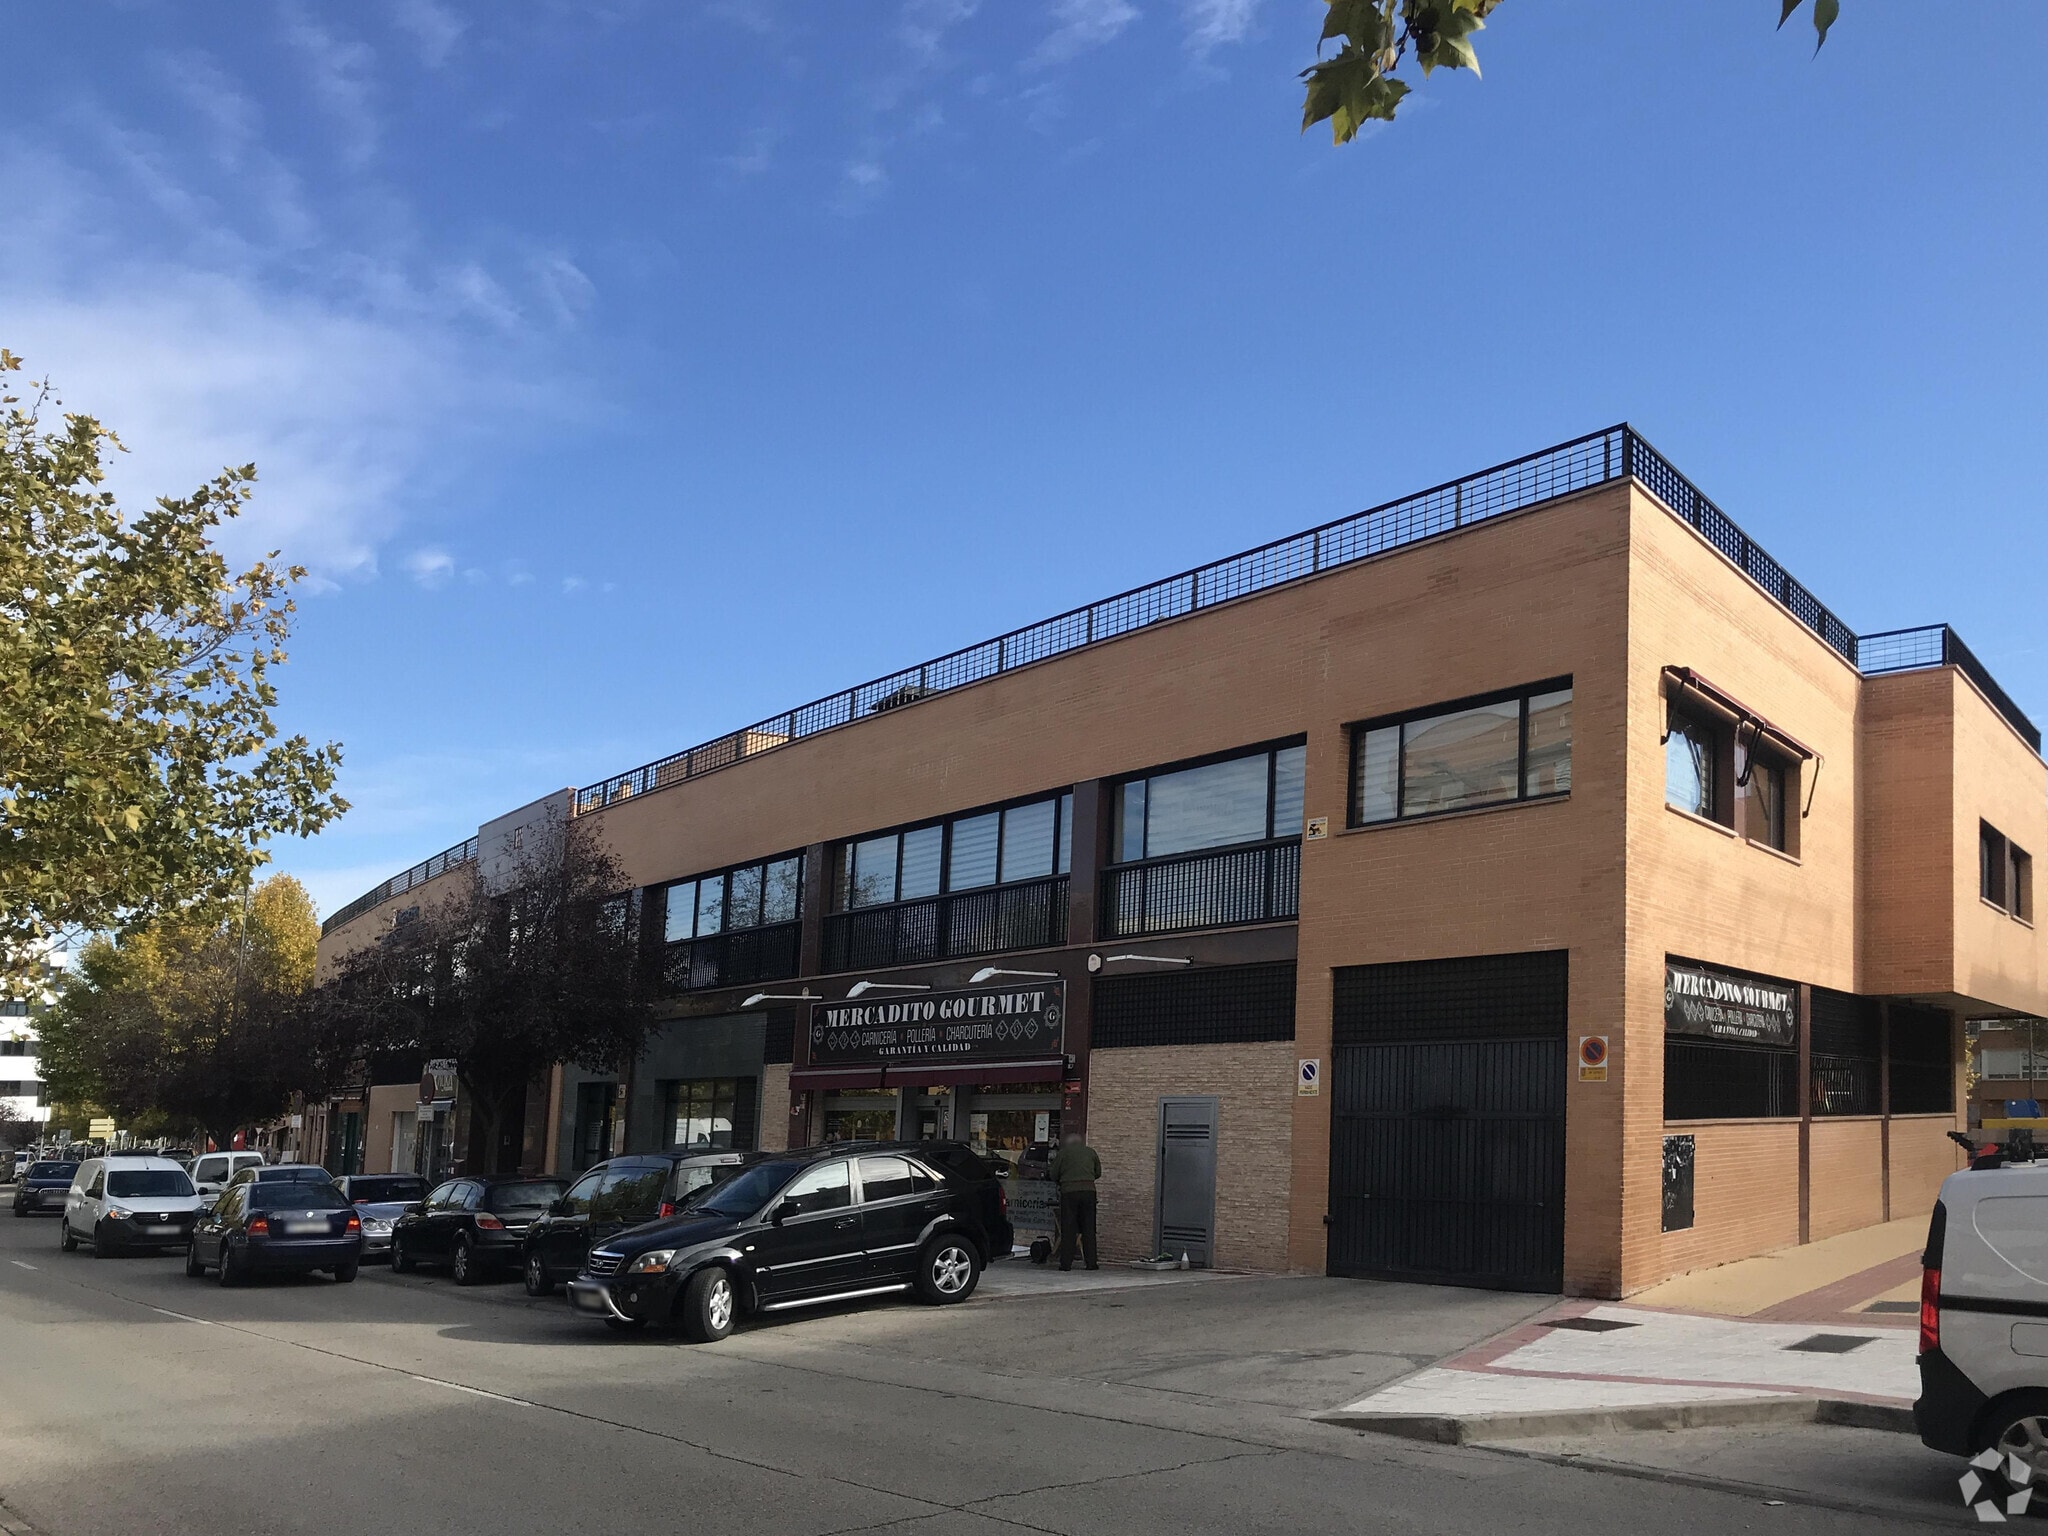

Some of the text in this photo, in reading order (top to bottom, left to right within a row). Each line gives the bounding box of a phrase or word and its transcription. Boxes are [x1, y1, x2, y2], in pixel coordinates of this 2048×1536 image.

[825, 991, 1045, 1028] MERCADITO GOURMET
[861, 1021, 993, 1047] CARNICERÍA POLLERÍA CHARCUTERÍA
[878, 1042, 971, 1056] GARANTÍA Y CALIDAD
